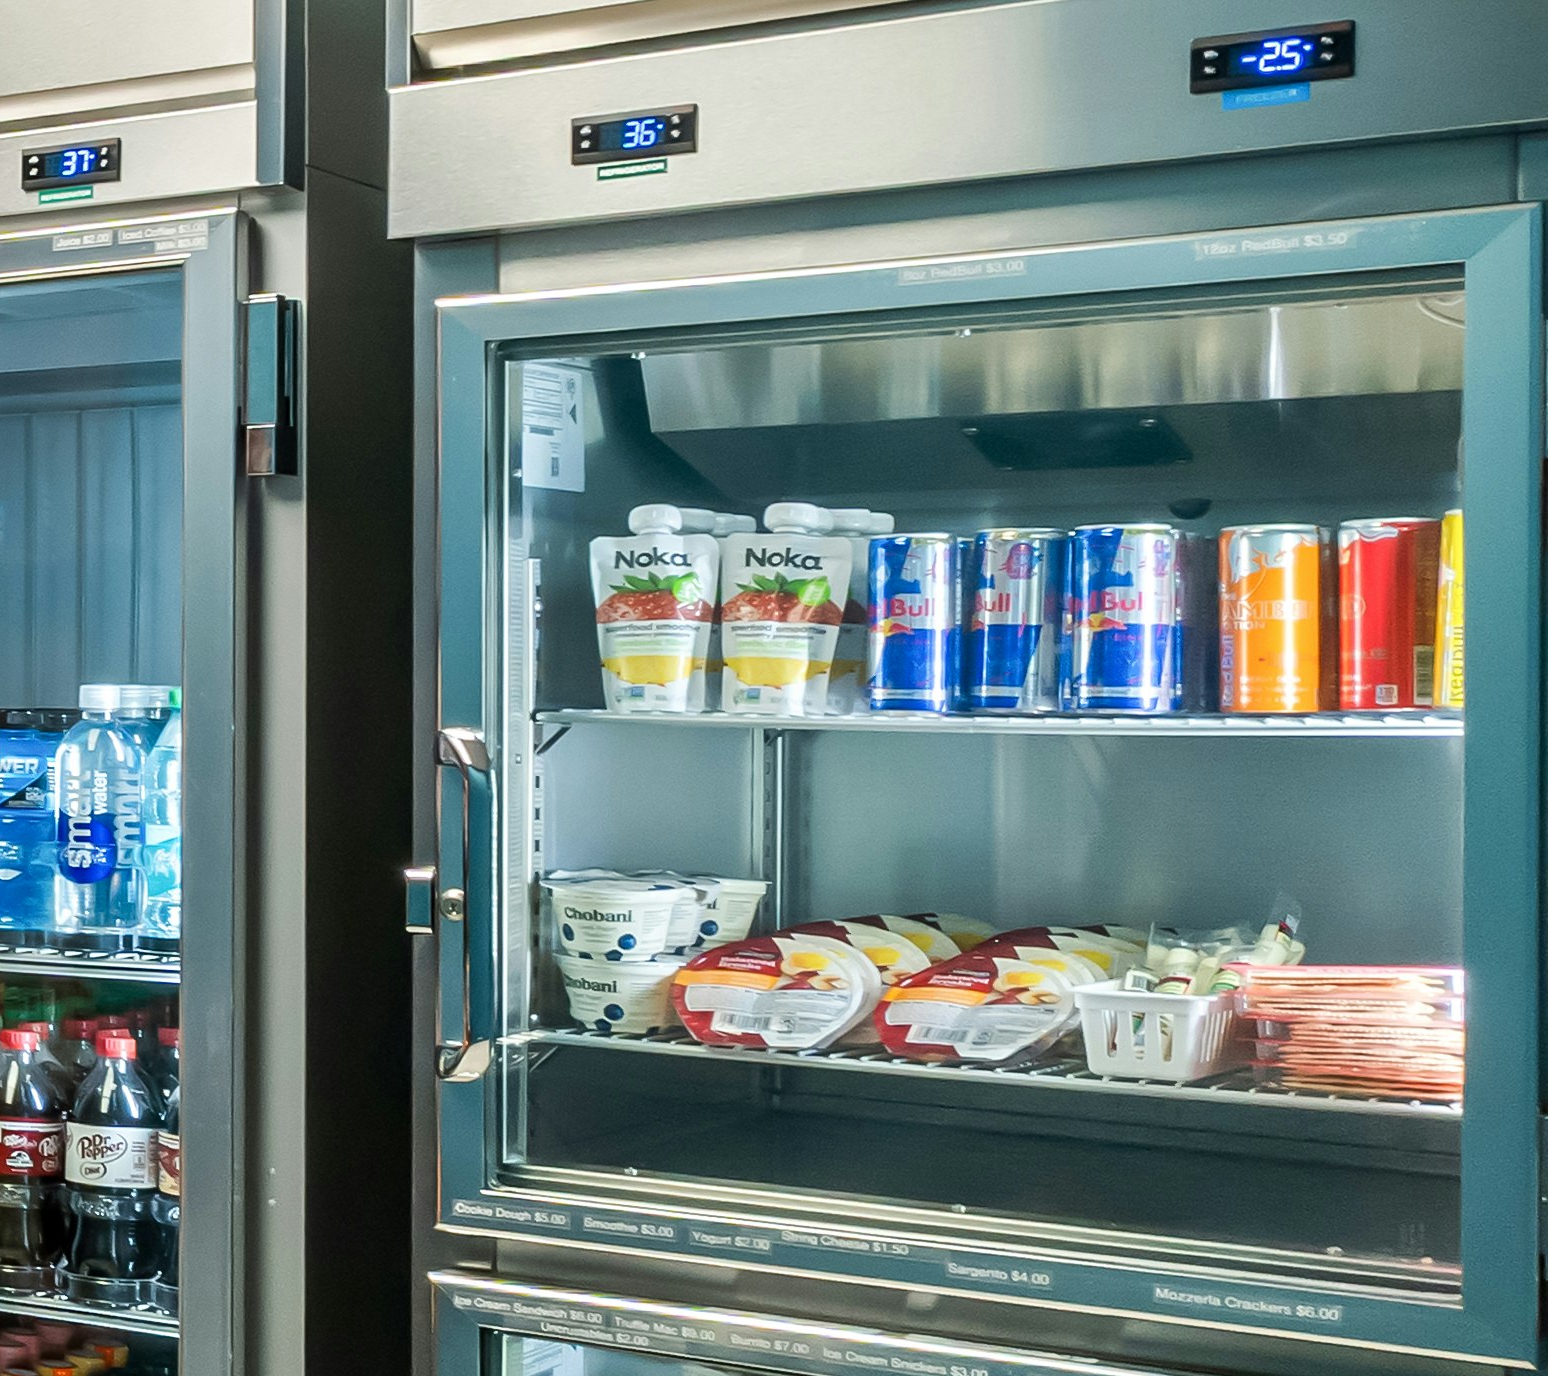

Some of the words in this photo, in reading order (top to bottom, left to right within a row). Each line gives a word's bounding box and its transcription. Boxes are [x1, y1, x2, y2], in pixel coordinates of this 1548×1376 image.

[622, 119, 656, 148] 36
[61, 150, 91, 176] 37
[55, 236, 81, 247] Juice
[1303, 234, 1347, 247] $3.50
[615, 547, 692, 570] Noka
[745, 547, 823, 571] Noka
[93, 771, 108, 814] water
[63, 775, 93, 868] smart
[564, 906, 632, 925] Chobani
[77, 1139, 124, 1163] Pepper
[92, 1135, 111, 1149] Dr
[455, 1203, 493, 1217] Cookie
[496, 1208, 531, 1221] Dough
[534, 1212, 567, 1225] $5.00
[583, 1217, 638, 1234] Smoothie
[641, 1225, 674, 1238] $3.00
[692, 1231, 732, 1247] Yogurt
[734, 1236, 769, 1250] $2.00
[781, 1230, 818, 1245] String
[820, 1235, 869, 1251] Cheese
[873, 1242, 909, 1255] $1.50
[948, 1263, 1008, 1280] Sargento
[1011, 1270, 1050, 1286] $4.00
[1224, 1297, 1292, 1315] Crackers
[823, 1347, 842, 1360] Ice
[845, 1351, 888, 1366] Cream
[890, 1357, 947, 1375] Snickers
